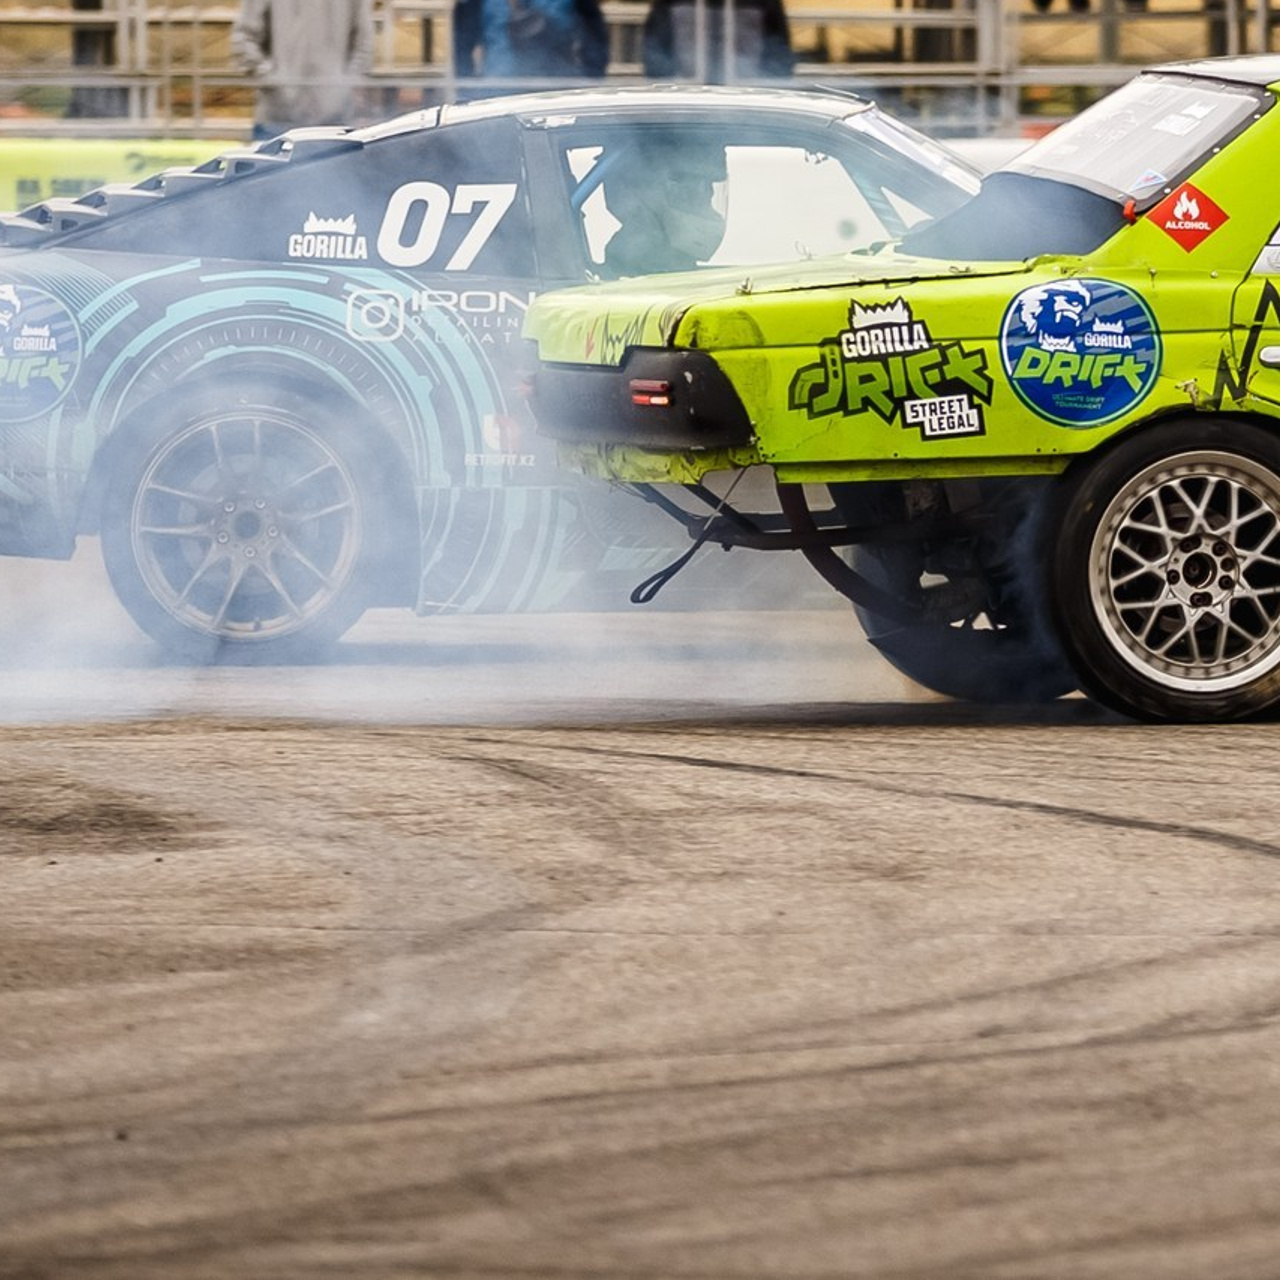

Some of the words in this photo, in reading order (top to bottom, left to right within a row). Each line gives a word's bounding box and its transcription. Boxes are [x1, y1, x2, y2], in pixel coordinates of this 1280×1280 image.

[377, 181, 517, 270] 07
[1165, 221, 1212, 231] ALCOHOL
[288, 234, 368, 260] GORILLA
[412, 290, 536, 313] IRON
[13, 336, 57, 351] GORILLA
[841, 323, 930, 358] GORILLA
[1084, 332, 1132, 348] GORILLA
[793, 344, 989, 418] DRIFT
[1012, 346, 1147, 394] DRIFT
[910, 397, 965, 419] STREET
[929, 412, 974, 433] LEGAL
